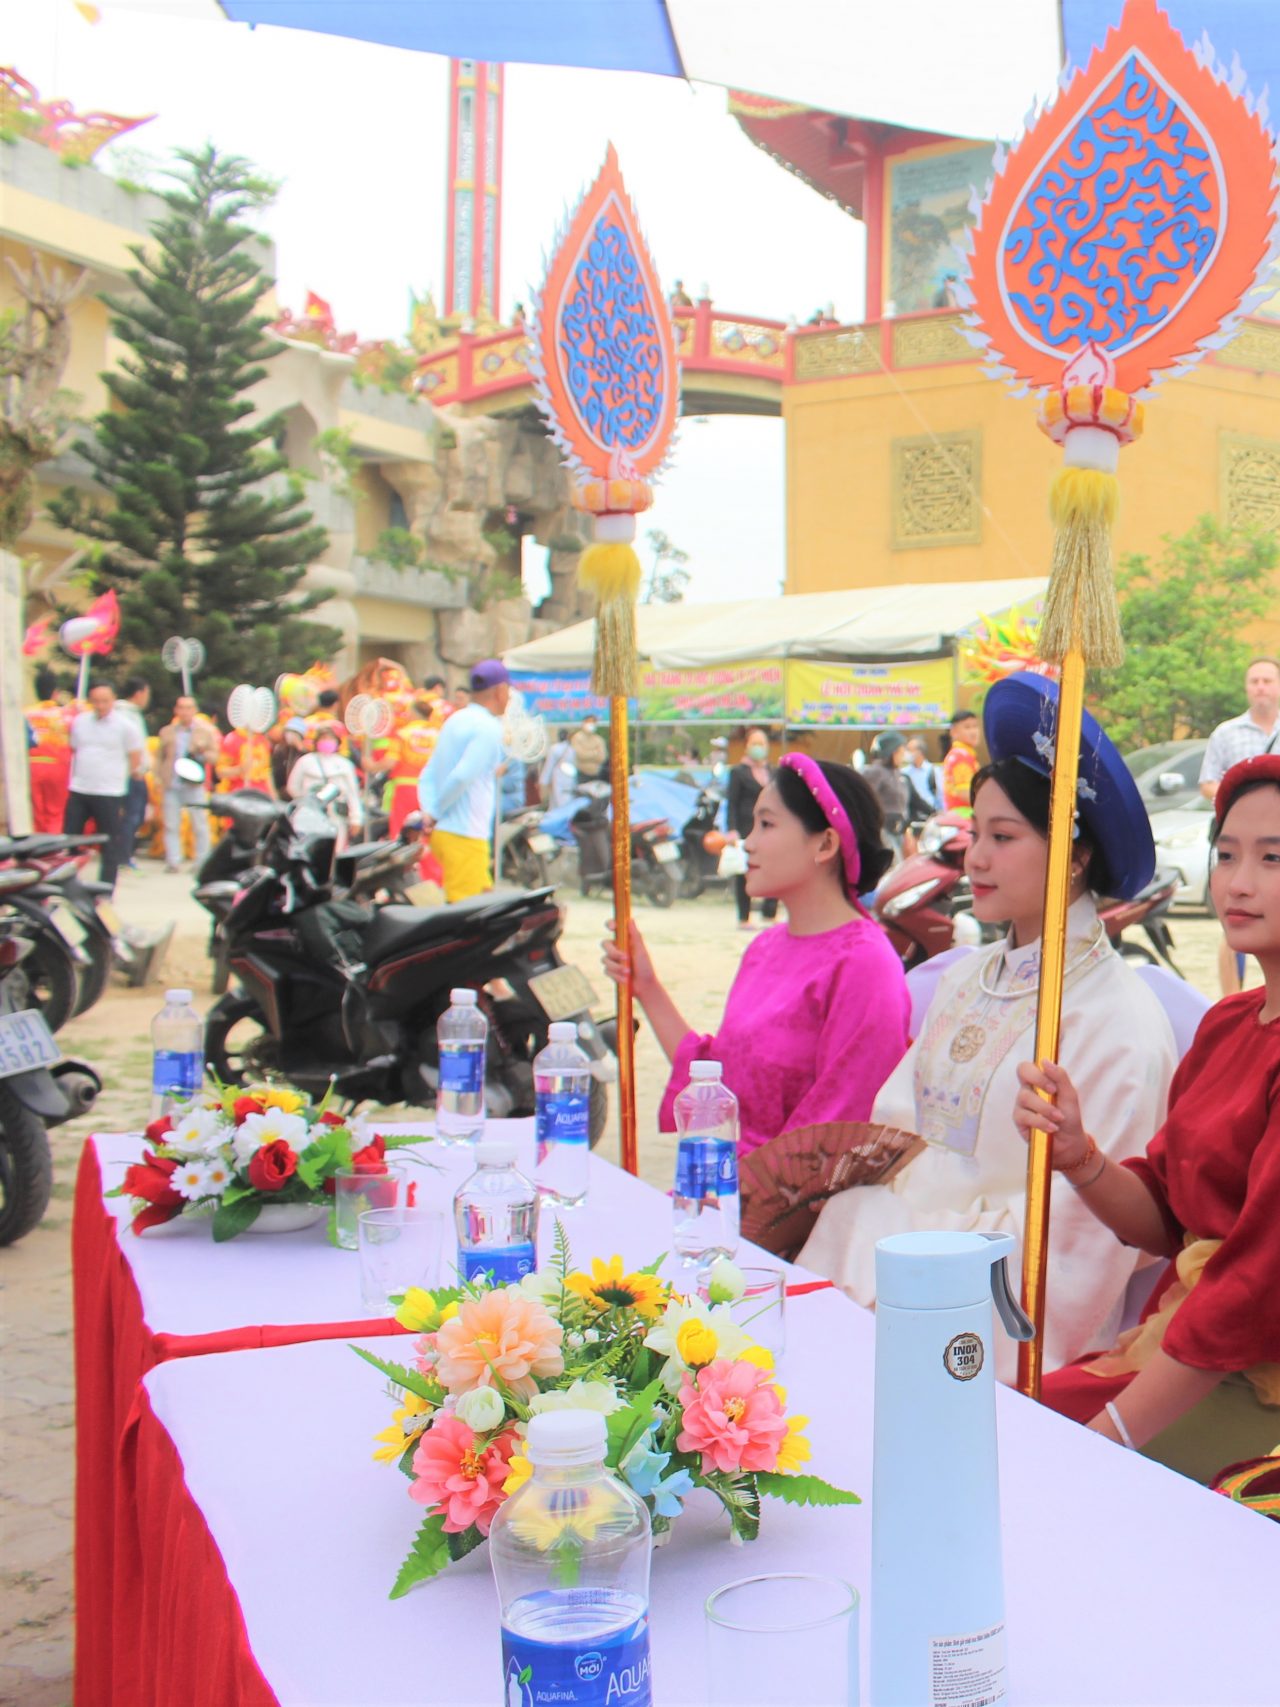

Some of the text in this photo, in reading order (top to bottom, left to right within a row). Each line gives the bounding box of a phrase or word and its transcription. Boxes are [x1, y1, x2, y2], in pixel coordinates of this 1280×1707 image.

[953, 1343, 978, 1356] INOX
[957, 1355, 975, 1366] 304
[536, 1690, 576, 1701] AQUAFINA
